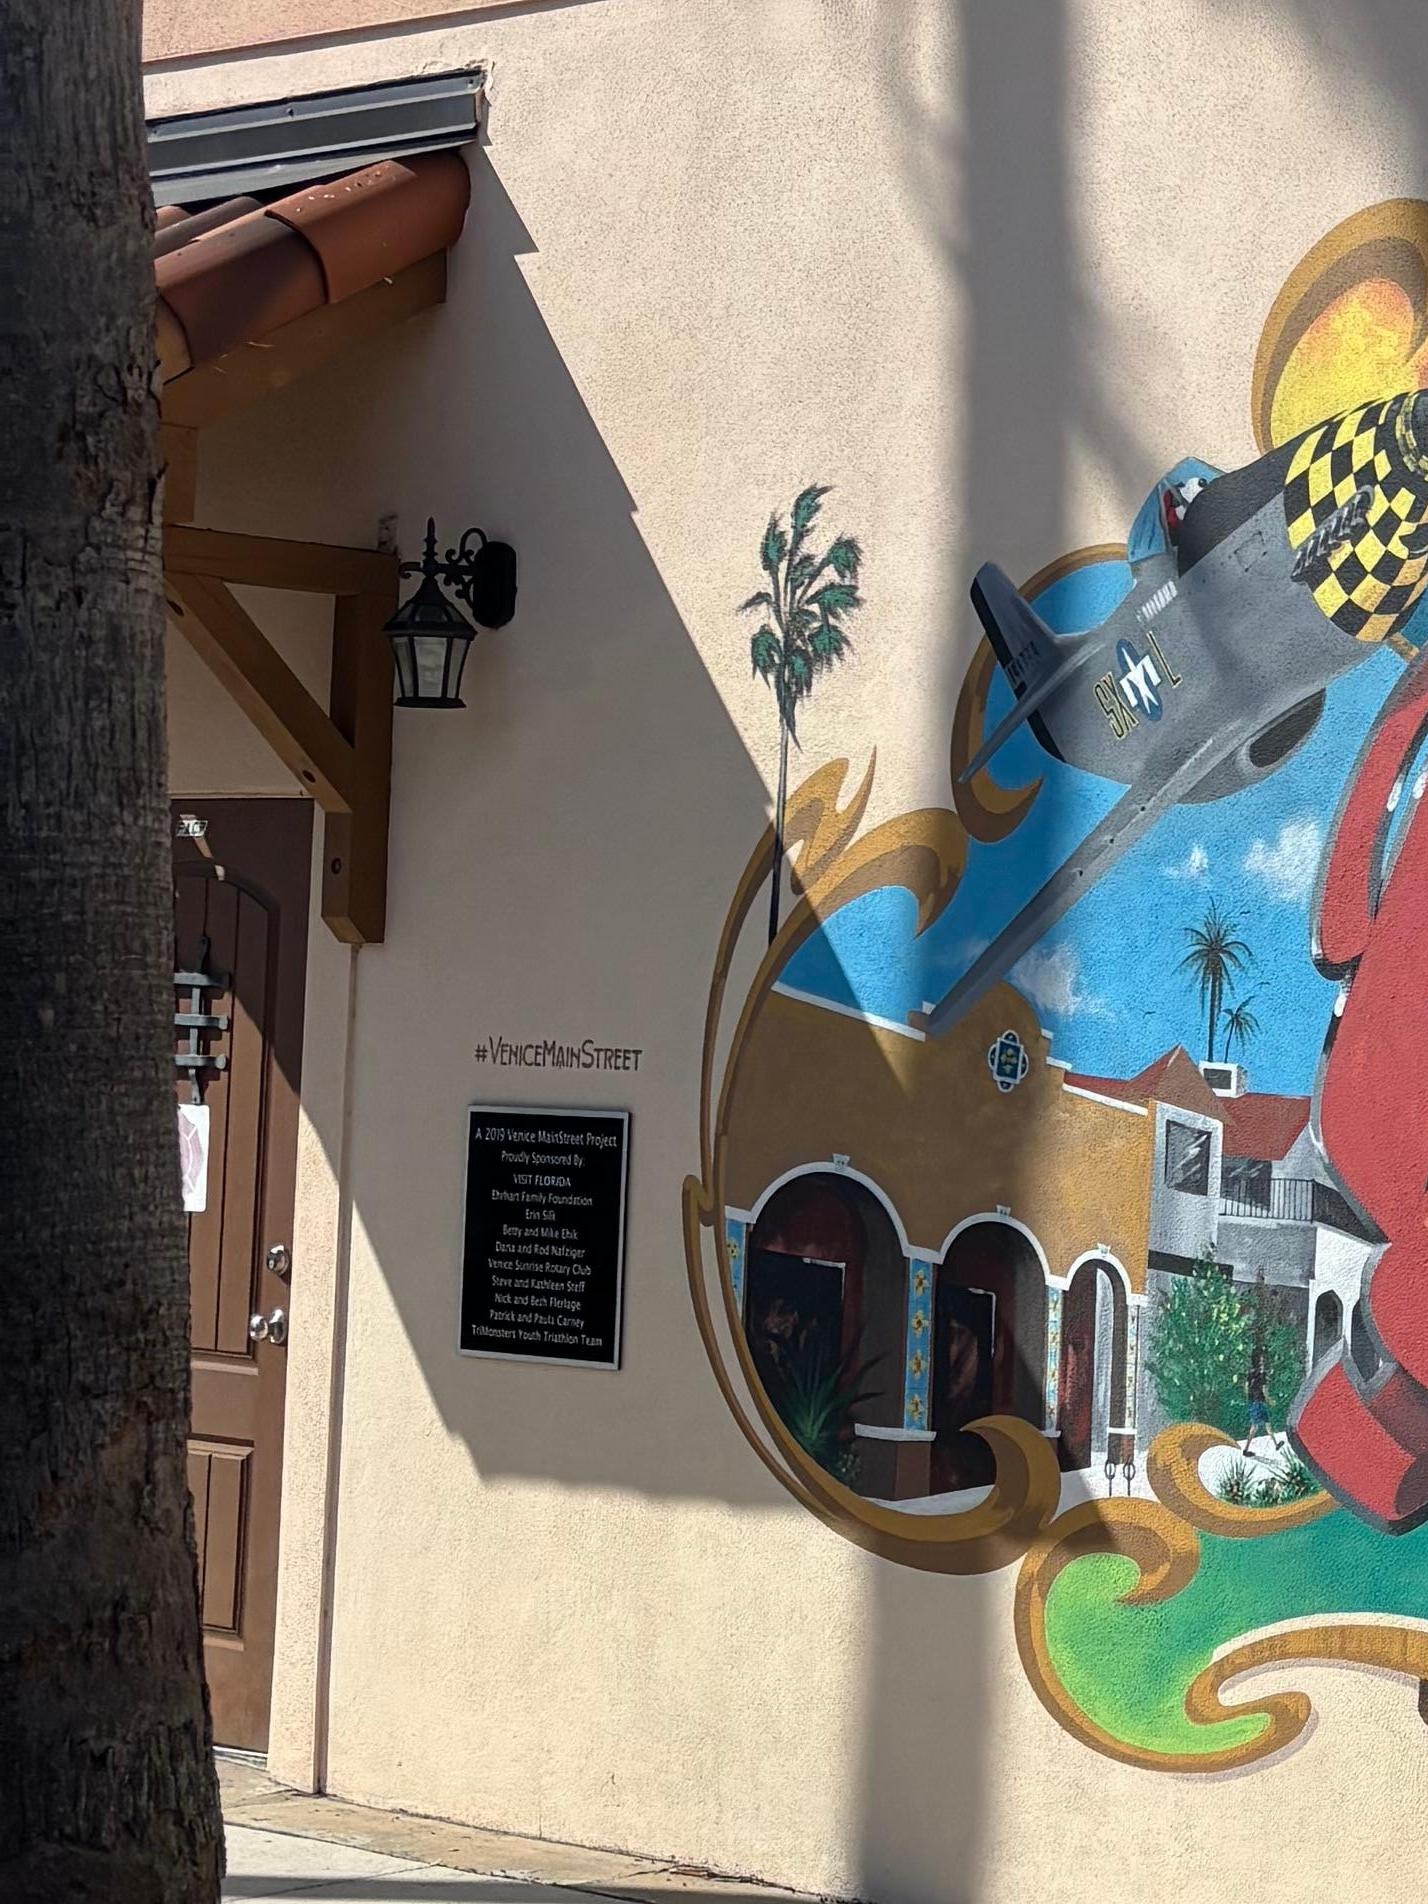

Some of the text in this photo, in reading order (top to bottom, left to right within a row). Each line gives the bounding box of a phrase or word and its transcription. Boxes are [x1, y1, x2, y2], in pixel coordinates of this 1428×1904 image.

[475, 1128, 617, 1149] A 2019 Venice MainStreet Project
[501, 1150, 530, 1165] Proudly
[531, 1152, 572, 1166] Sponsored
[513, 1174, 572, 1187] VISIT FLORIDA
[521, 1191, 547, 1205] Family
[548, 1193, 593, 1206] Foundation
[525, 1209, 540, 1220] Erin
[523, 1226, 539, 1237] and
[540, 1227, 560, 1239] Mike
[517, 1243, 532, 1255] and
[534, 1244, 549, 1256] Rod
[488, 1258, 592, 1276] Venice Sunrise Rotary Club
[491, 1275, 512, 1288] Steve
[514, 1277, 529, 1289] and
[531, 1278, 565, 1291] Kathleen
[494, 1293, 512, 1304] Nick
[513, 1294, 529, 1305] and
[489, 1309, 515, 1322] Patrick
[517, 1312, 532, 1323] and
[556, 1315, 584, 1329] Carney
[518, 1328, 541, 1342] Youth
[544, 1331, 579, 1344] Triathlon
[581, 1334, 603, 1346] Team
